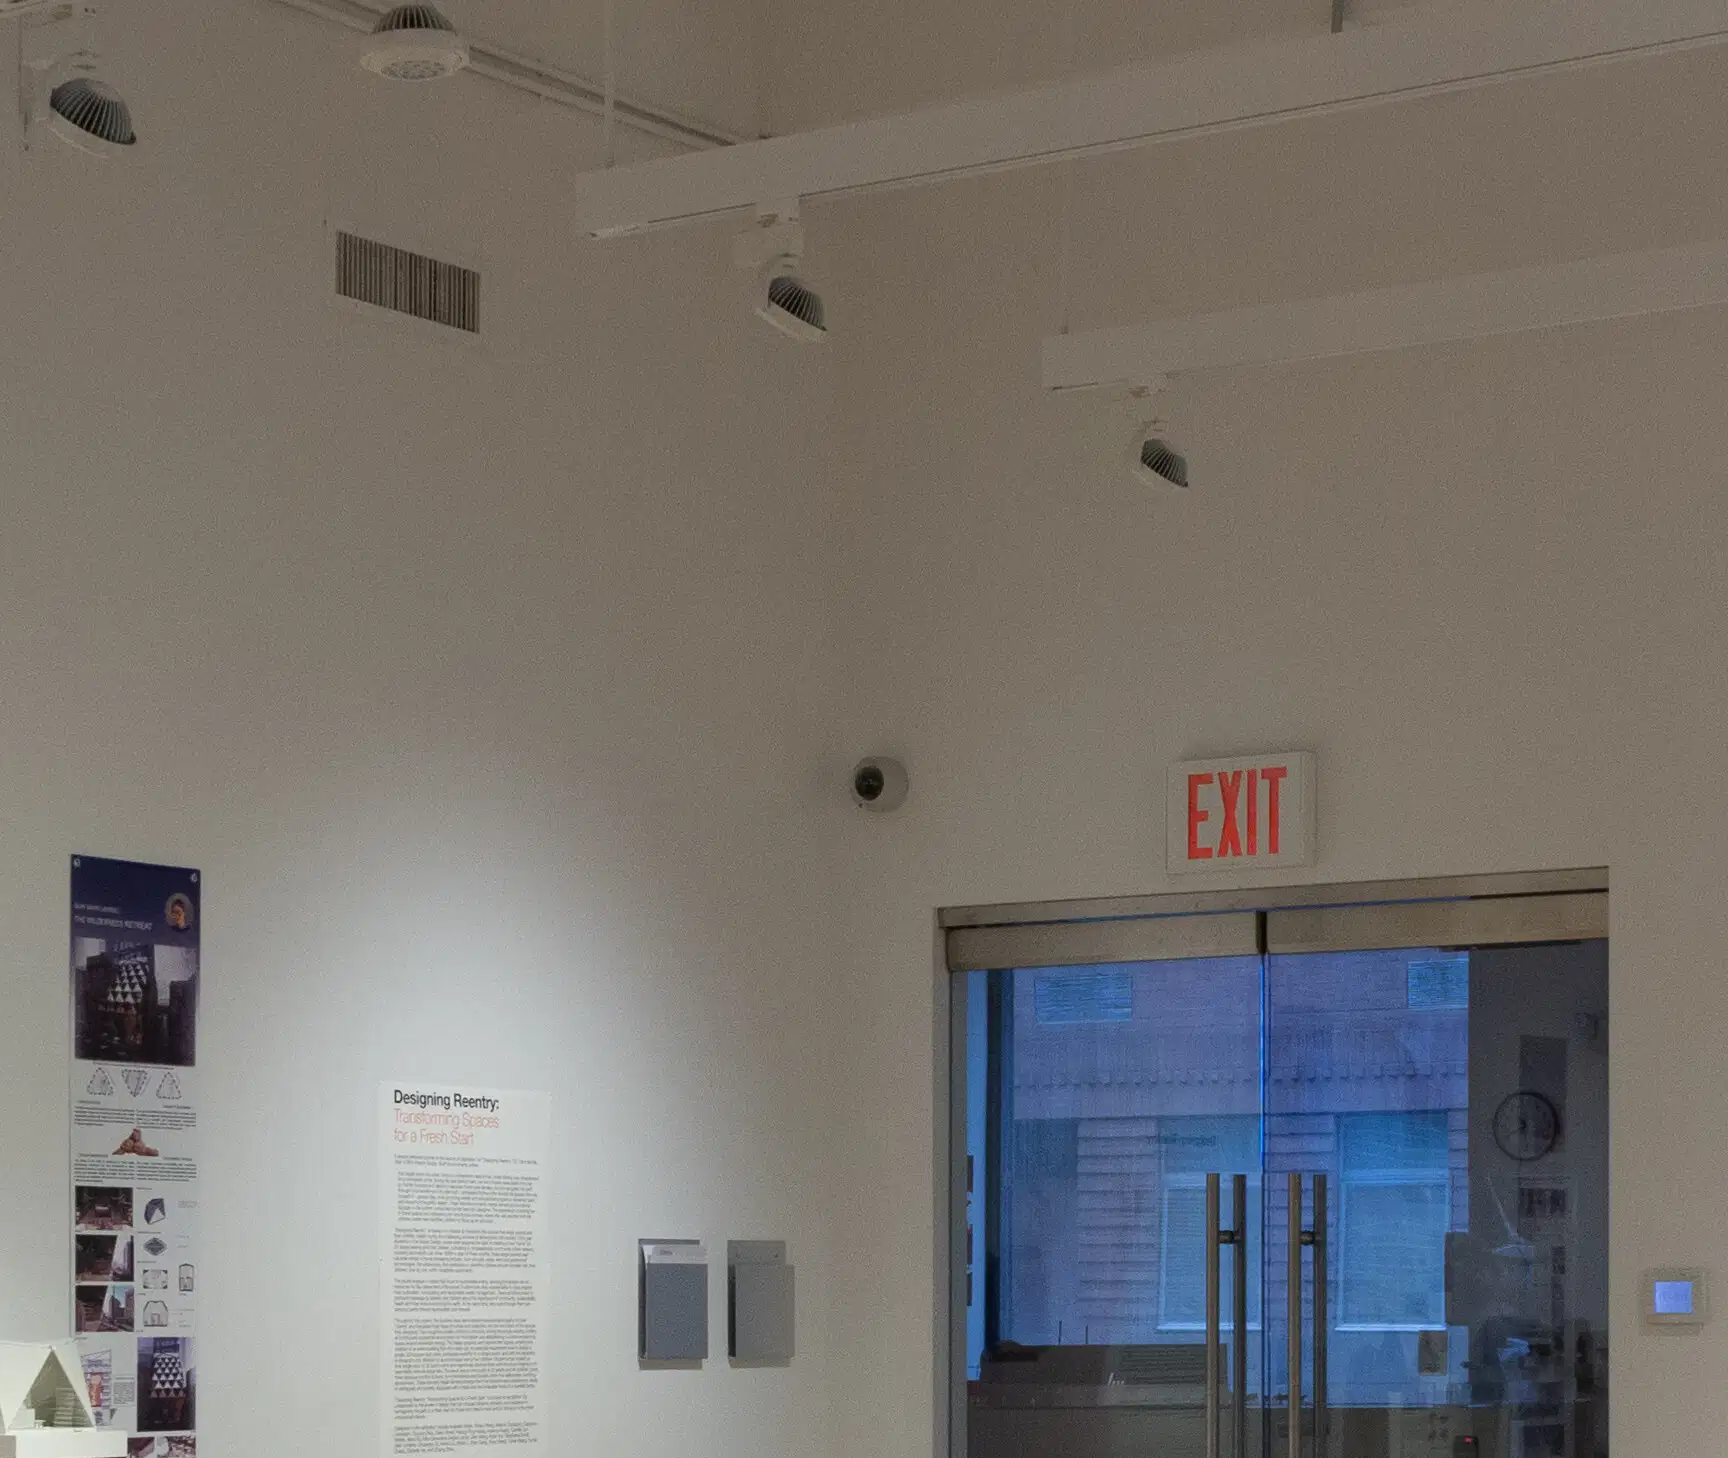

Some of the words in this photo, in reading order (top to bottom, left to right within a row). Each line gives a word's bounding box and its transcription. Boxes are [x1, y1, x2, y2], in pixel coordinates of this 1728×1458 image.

[1188, 766, 1288, 860] EXIT
[394, 1089, 451, 1110] Designing
[453, 1093, 500, 1112] Reentry:
[394, 1108, 460, 1129] Transforming
[462, 1112, 500, 1129] Spaces
[394, 1128, 408, 1142] for
[410, 1132, 417, 1143] a
[420, 1129, 448, 1144] Fresh
[451, 1131, 474, 1145] Start
